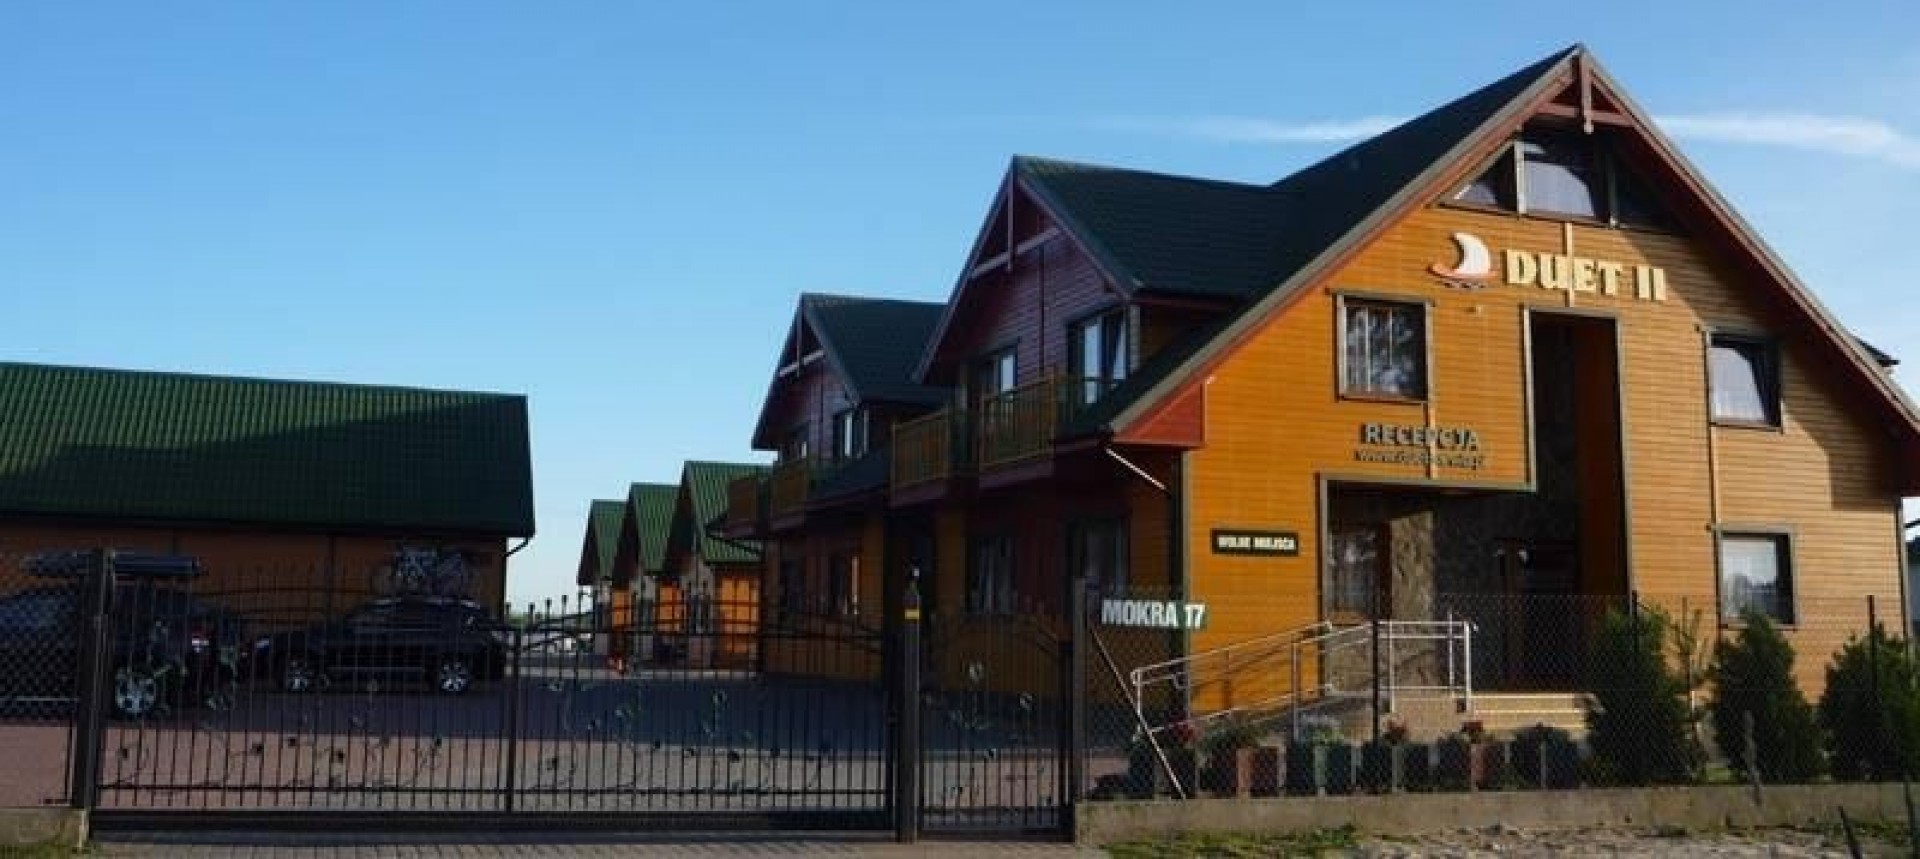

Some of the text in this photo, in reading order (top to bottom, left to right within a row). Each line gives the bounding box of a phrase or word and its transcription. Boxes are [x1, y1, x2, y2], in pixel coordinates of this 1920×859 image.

[1505, 249, 1666, 301] DUET II
[1362, 424, 1479, 450] RECEPCJA
[1102, 600, 1206, 629] MOKRA 17
